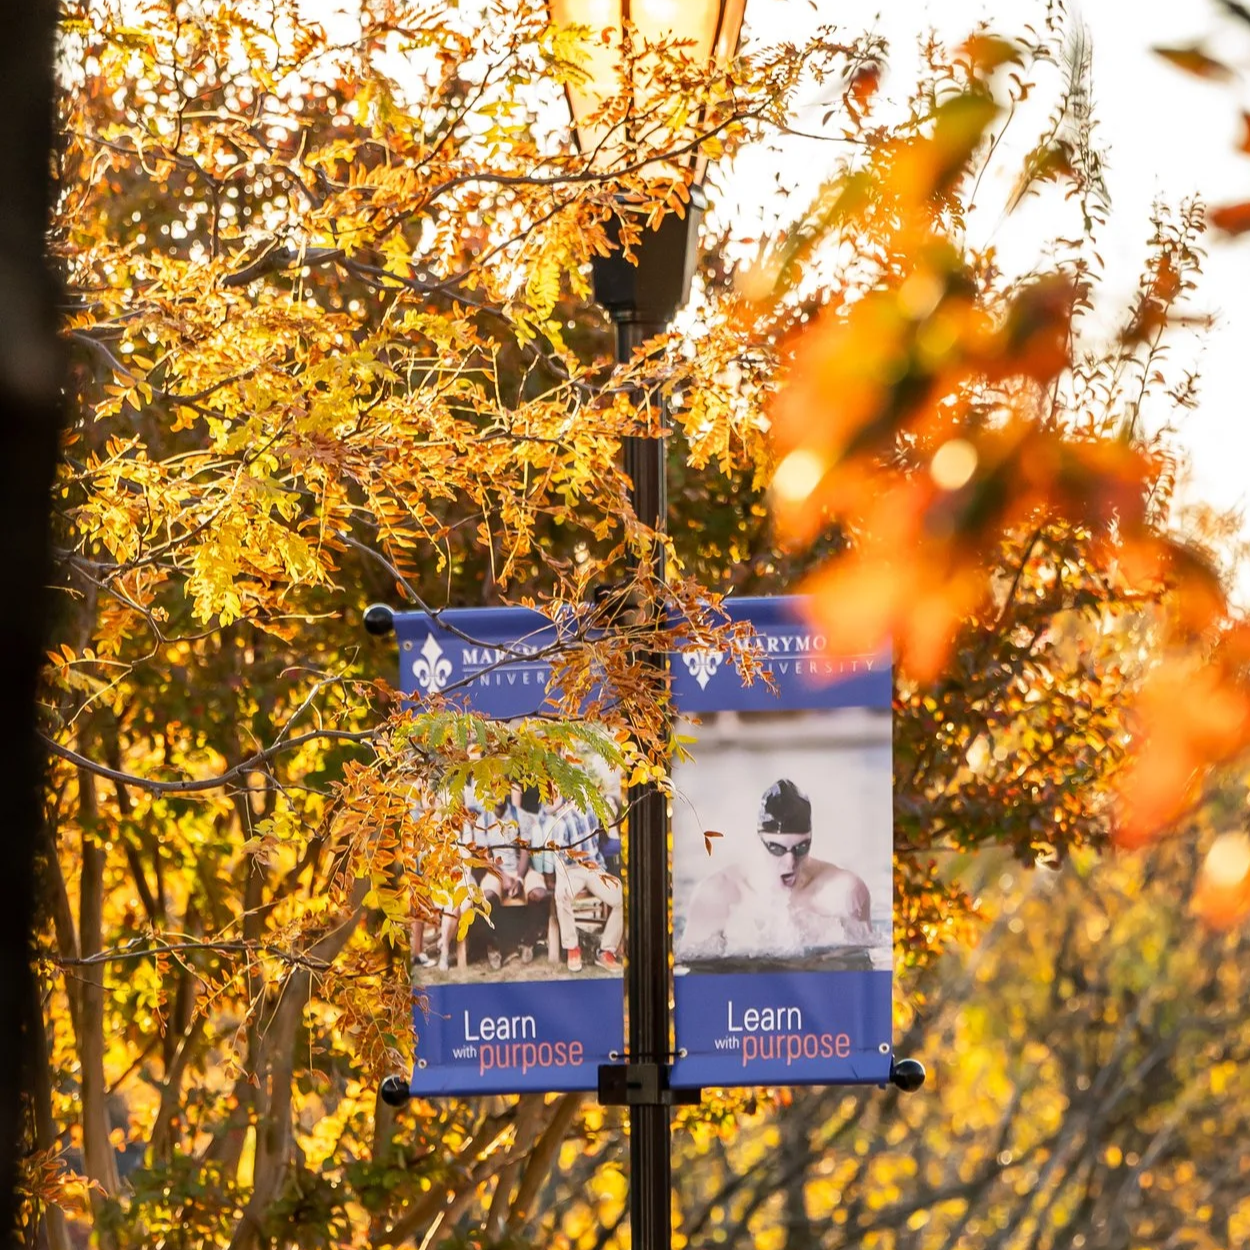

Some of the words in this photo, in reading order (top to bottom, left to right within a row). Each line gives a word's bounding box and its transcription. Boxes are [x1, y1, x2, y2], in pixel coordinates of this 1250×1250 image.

[735, 634, 828, 653] MARYMO
[464, 671, 546, 688] NIVER
[464, 1009, 537, 1041] Learn
[727, 1000, 802, 1032] Learn
[452, 1044, 478, 1059] with
[479, 1039, 584, 1077] purpose
[714, 1035, 740, 1050] with
[742, 1032, 850, 1067] purpose
